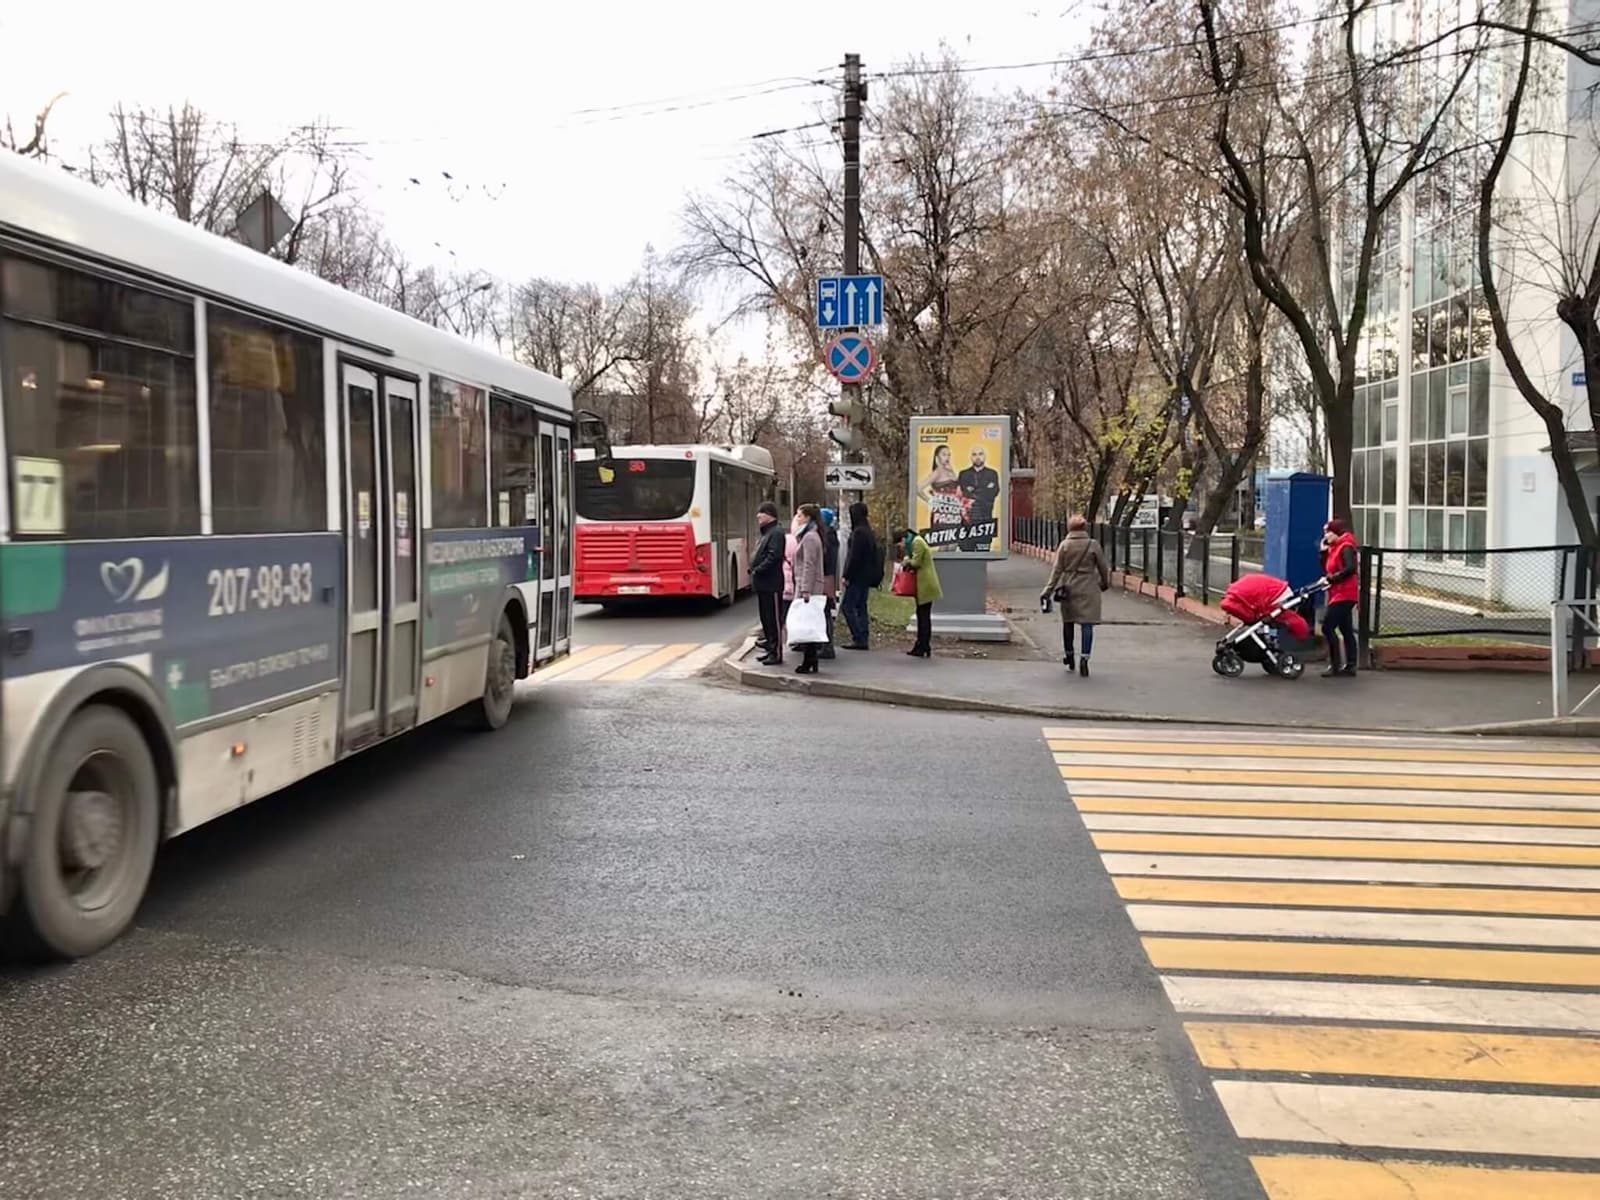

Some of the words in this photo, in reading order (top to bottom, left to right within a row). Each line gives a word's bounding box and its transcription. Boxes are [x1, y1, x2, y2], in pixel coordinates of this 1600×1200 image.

[924, 528, 957, 544] ARTIK
[960, 527, 967, 539] &
[968, 522, 995, 538] ASTI
[208, 562, 312, 617] 207-98-83
